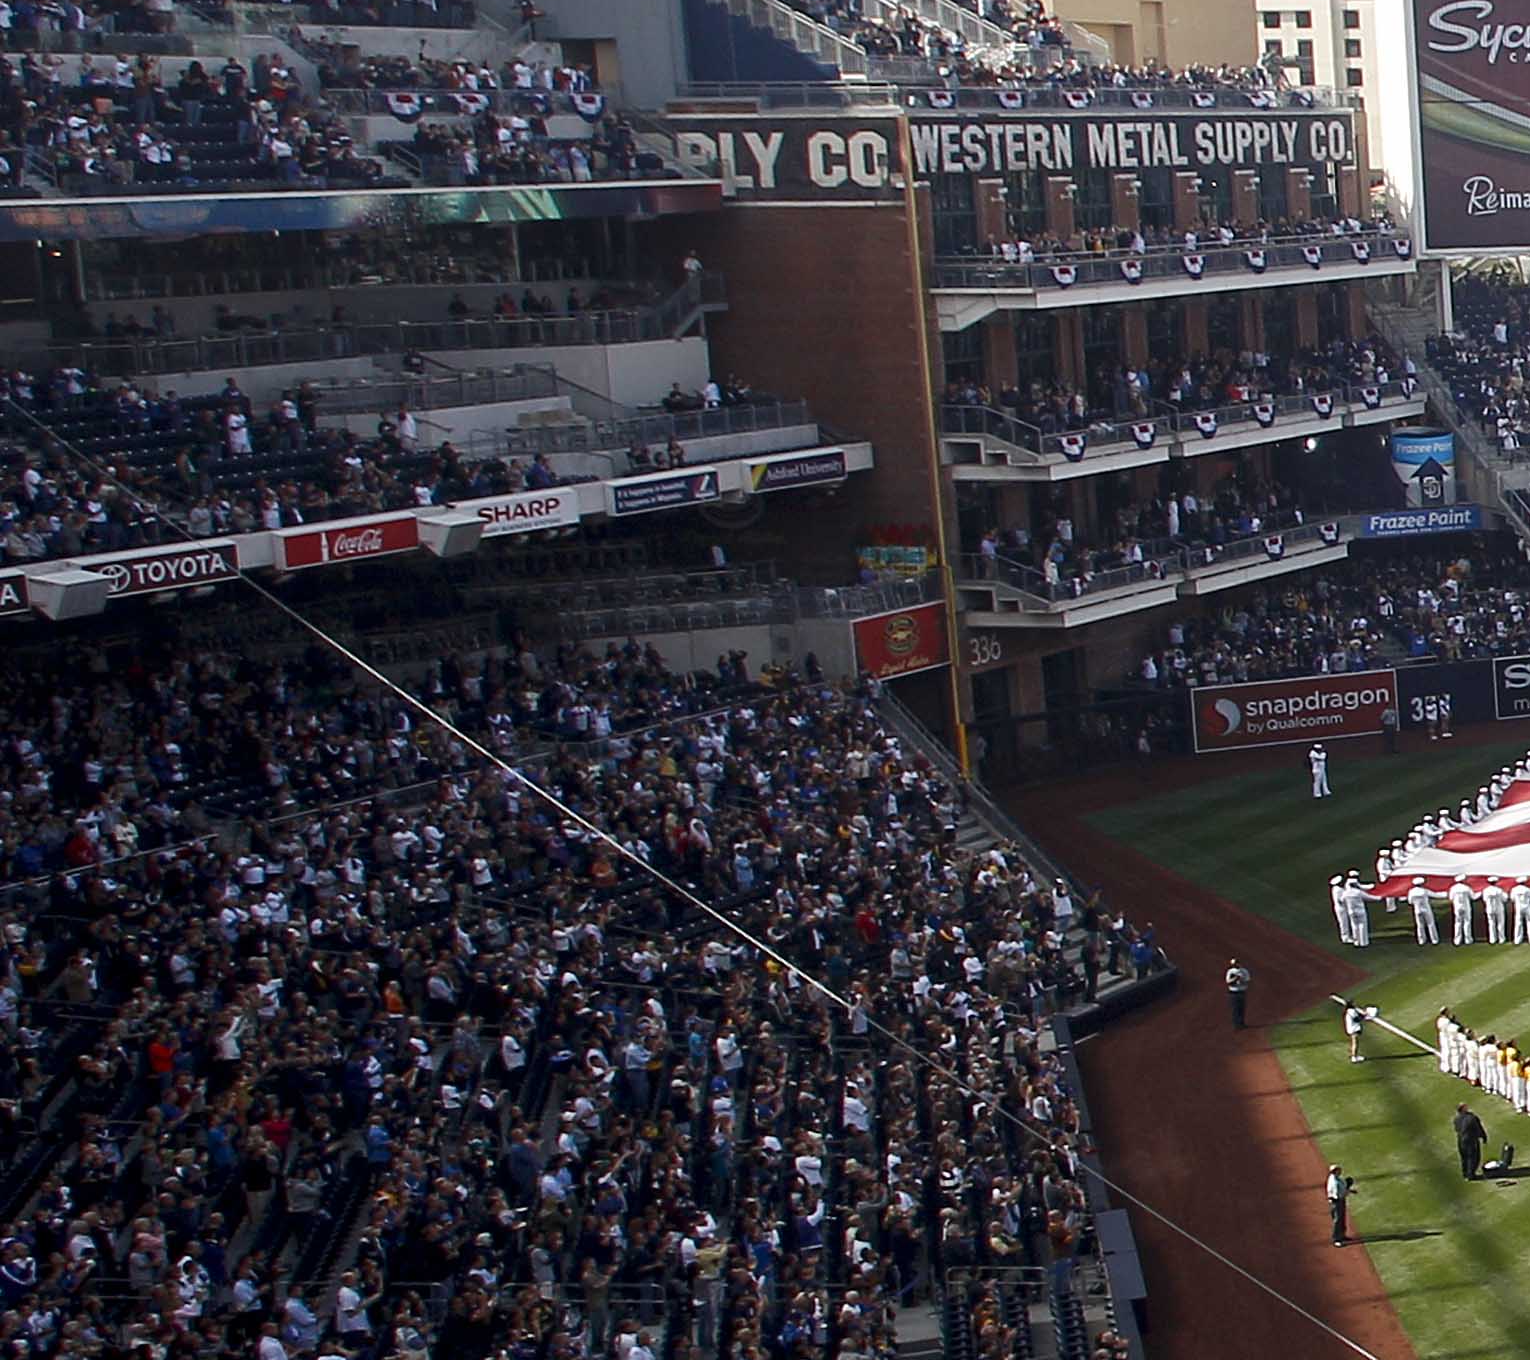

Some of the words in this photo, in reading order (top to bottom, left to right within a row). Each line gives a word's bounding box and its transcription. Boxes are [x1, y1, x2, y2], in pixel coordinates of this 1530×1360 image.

[910, 123, 1072, 171] WESTERN
[1087, 121, 1188, 168] METAL
[1196, 120, 1299, 164] SUPPLY
[1309, 120, 1353, 162] CO.
[477, 498, 560, 523] SHARP
[1370, 514, 1425, 530] Frazee
[1428, 509, 1472, 525] Paint
[132, 553, 228, 585] TOYOTA
[971, 636, 1001, 666] 336
[1246, 688, 1389, 717] snapdragon
[1247, 722, 1263, 734] by
[1267, 713, 1343, 731] Qualcomm
